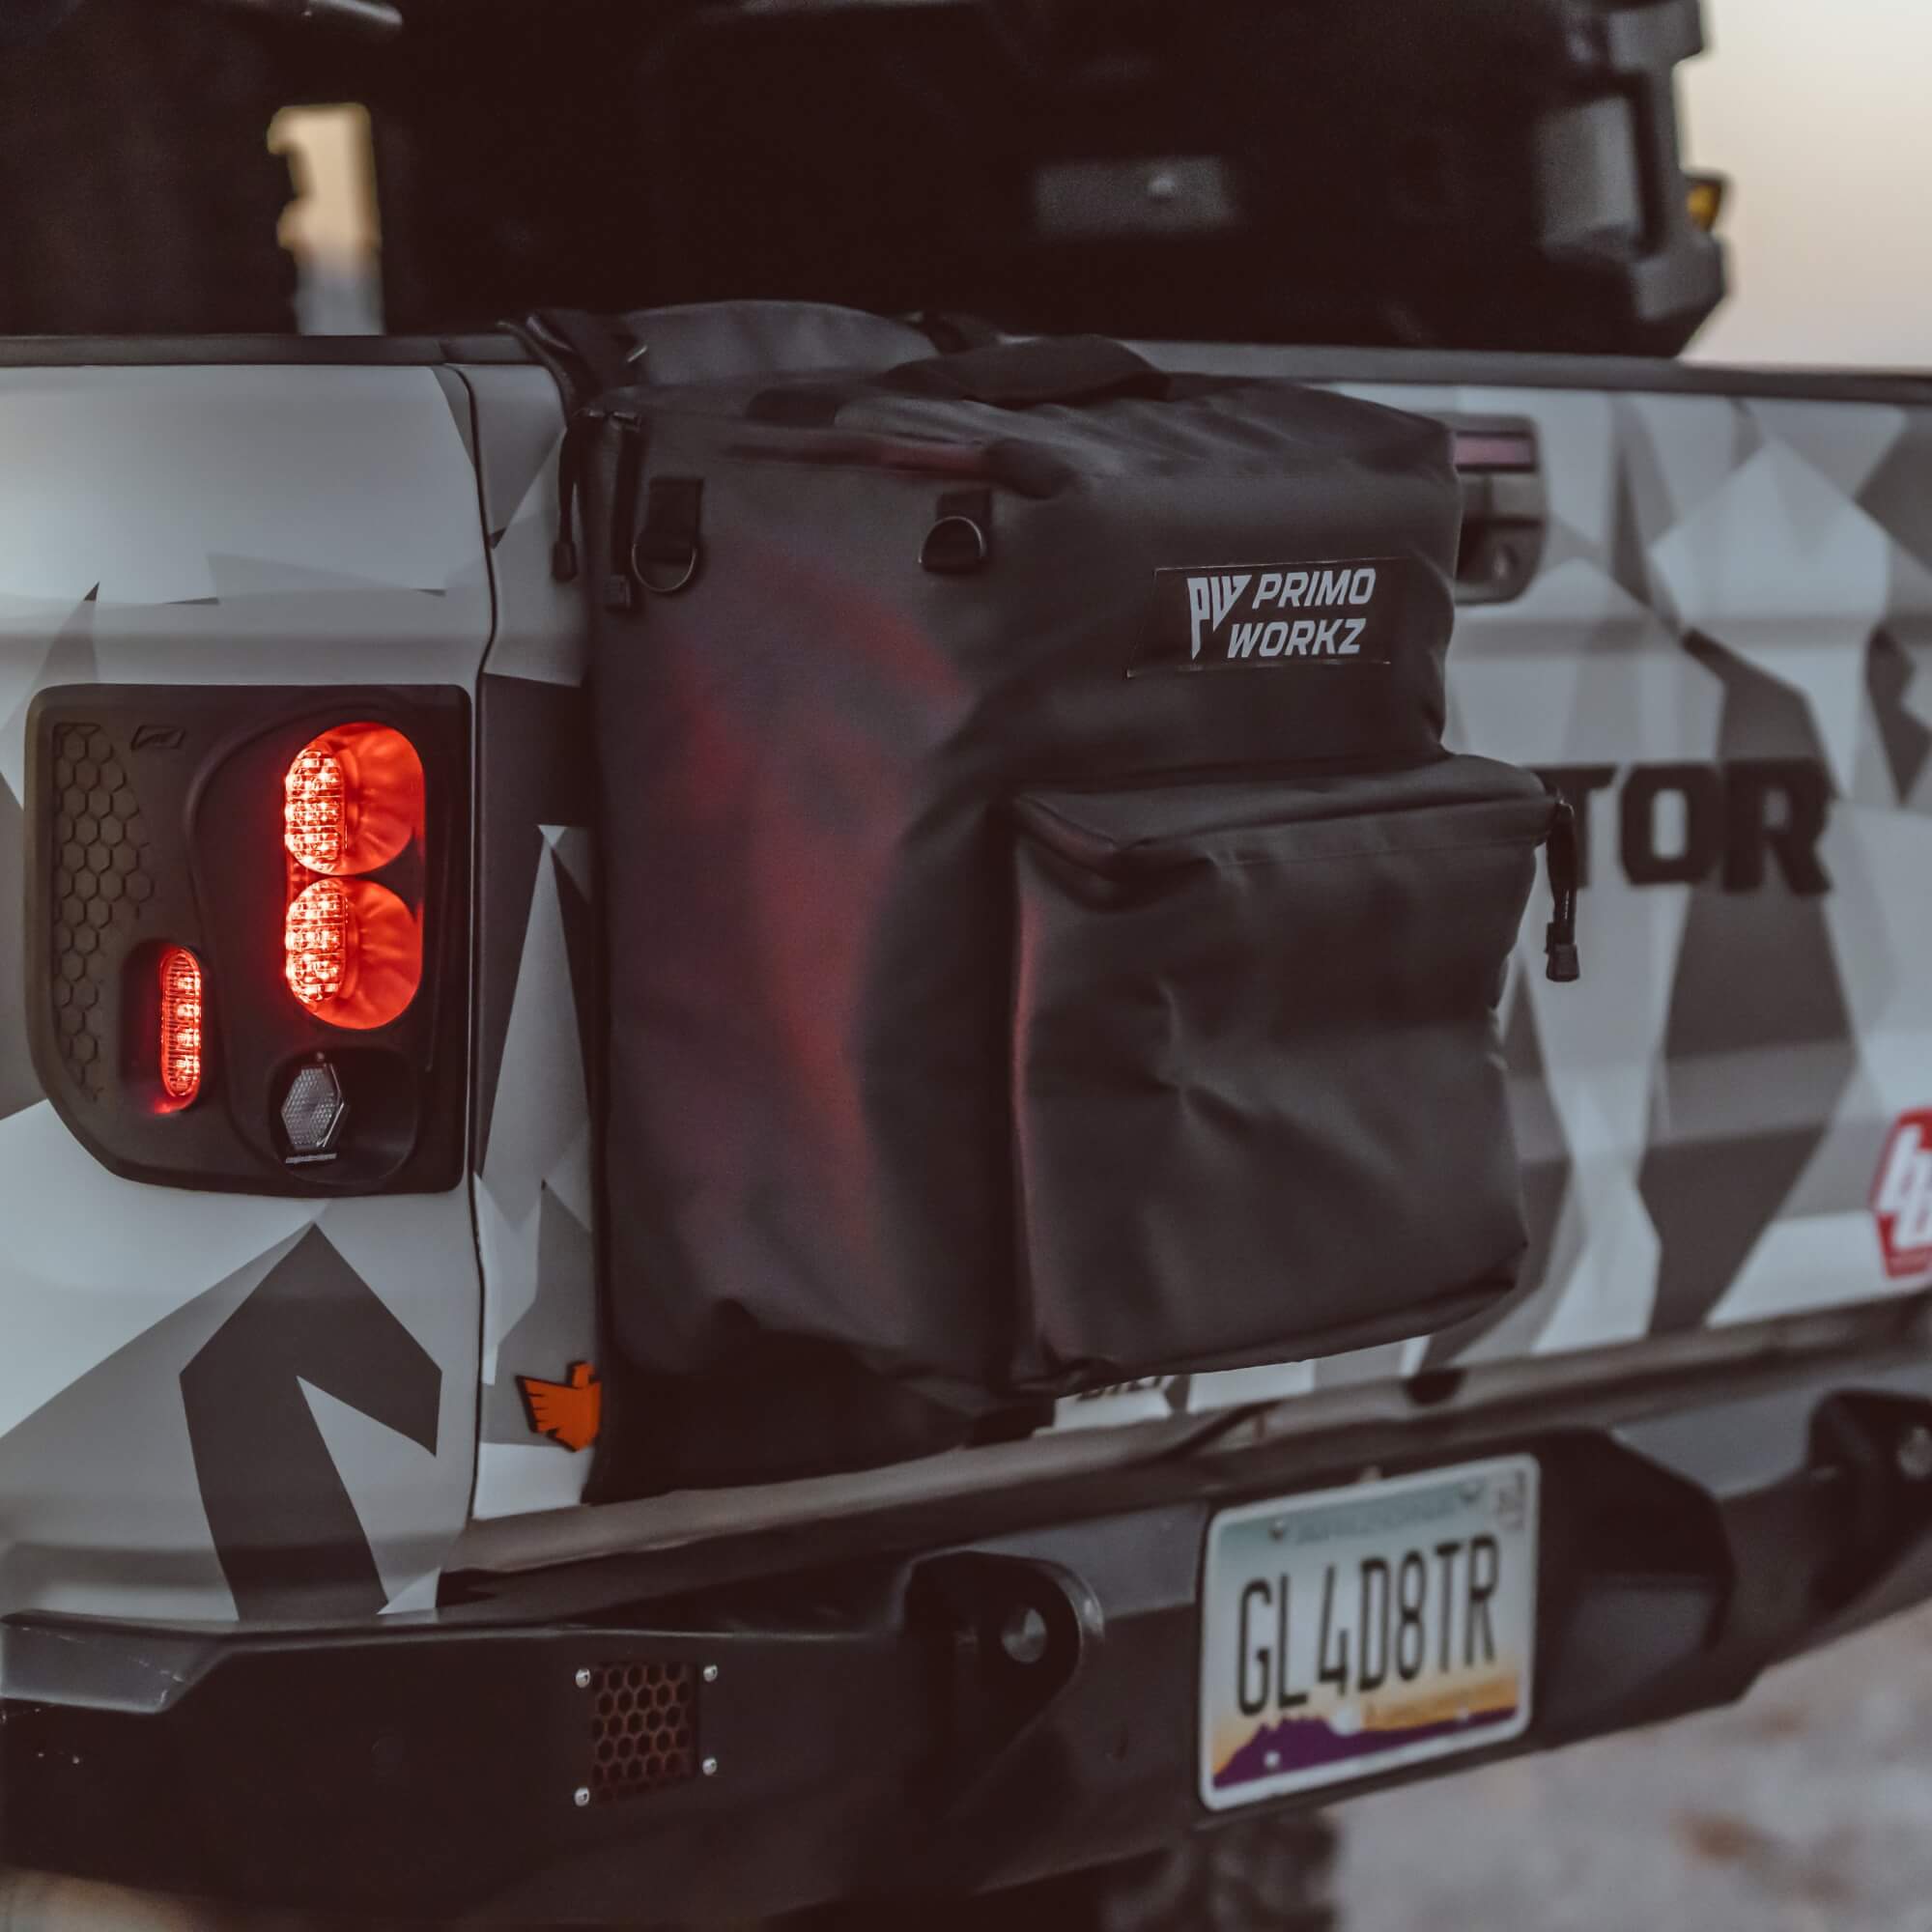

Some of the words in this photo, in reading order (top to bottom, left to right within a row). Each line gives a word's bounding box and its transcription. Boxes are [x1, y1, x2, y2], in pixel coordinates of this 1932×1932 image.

[1252, 567, 1377, 610] PRIMO
[1227, 617, 1367, 659] WORKZ
[1237, 1531, 1499, 1718] GL4D8TR
